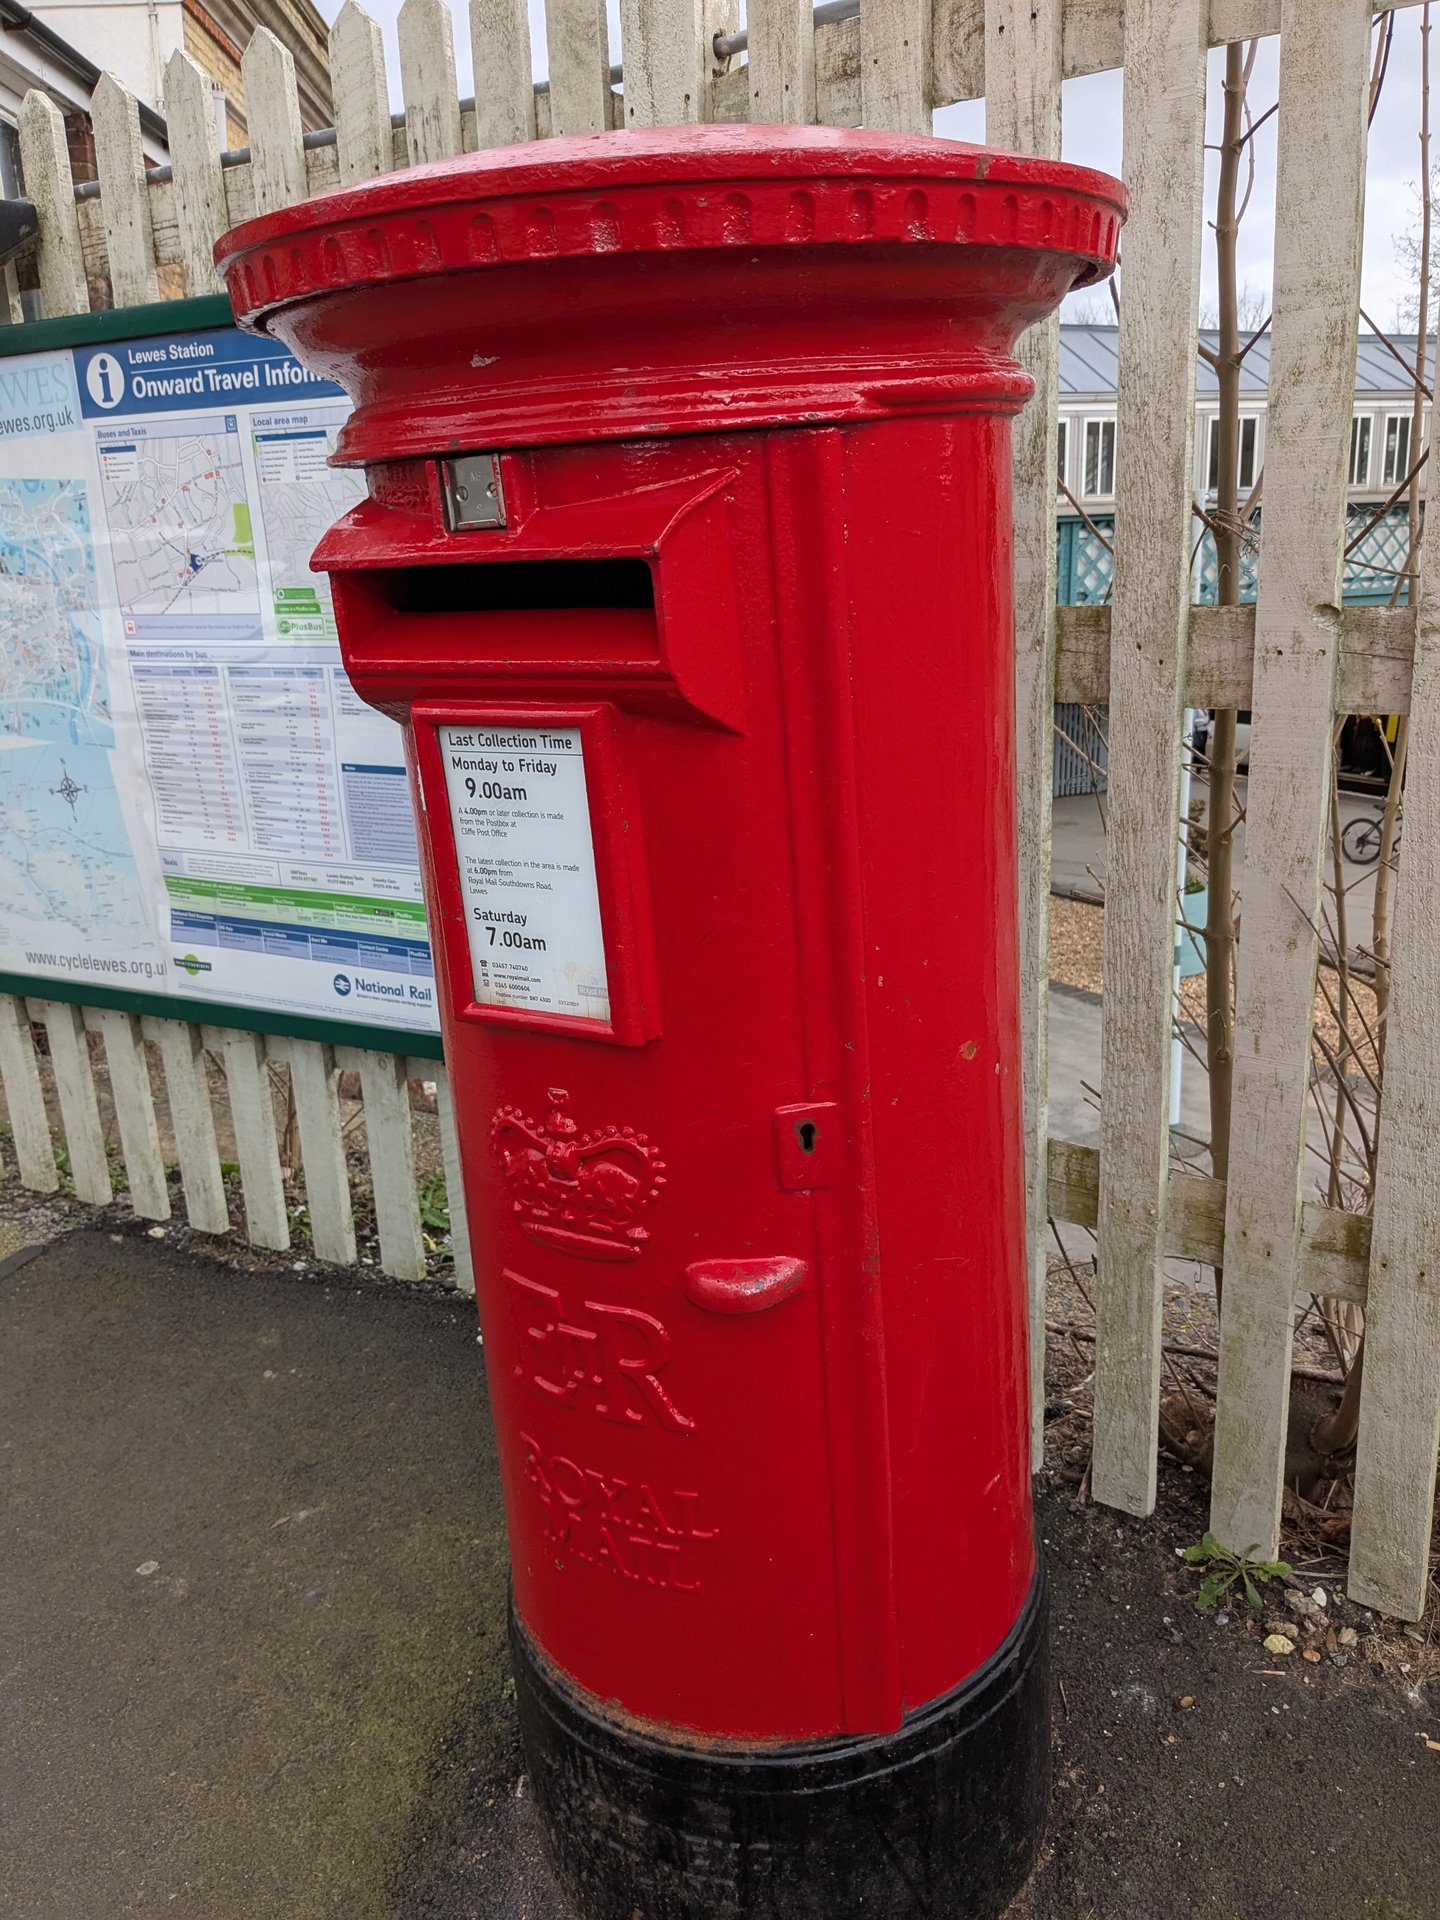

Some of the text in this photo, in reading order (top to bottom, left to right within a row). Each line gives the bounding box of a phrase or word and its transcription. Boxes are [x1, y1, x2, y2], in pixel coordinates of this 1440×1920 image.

[128, 342, 214, 364] Lewes Station
[0, 363, 70, 410] WES
[132, 371, 204, 398] Onward
[204, 364, 260, 391] Travel
[252, 415, 308, 427] Local area map
[97, 427, 147, 439] Buses and Taxis
[291, 622, 322, 631] PlusBus
[130, 649, 145, 657] Main
[146, 650, 184, 659] destinations
[448, 732, 572, 749] Last Collection Time
[452, 756, 557, 776] Monday to Friday
[465, 777, 527, 800] 9.00am
[464, 807, 488, 816] 4.00pm
[496, 808, 510, 817] later
[511, 811, 539, 819] collection
[540, 811, 546, 819] is
[546, 812, 564, 820] made
[459, 817, 517, 828] from the Postbox at
[461, 827, 508, 838] Cliffe Post Office
[465, 856, 477, 864] The
[477, 857, 494, 866] latest
[494, 858, 522, 868] collection
[522, 860, 530, 868] in
[530, 861, 540, 869] the
[541, 862, 555, 870] area
[562, 864, 580, 872] made
[474, 867, 498, 877] 6.00pm
[498, 868, 514, 877] from
[468, 876, 554, 891] Royal Mail Southdowns Road,
[469, 886, 489, 895] Lewes
[473, 907, 527, 927] Saturday
[485, 926, 546, 951] 7.00am
[493, 972, 542, 983] www.royalmail.com
[355, 978, 432, 1001] National Rail
[494, 982, 508, 990] 0345
[520, 1430, 721, 1541] ROYAL
[540, 1494, 702, 1591] MAIL
